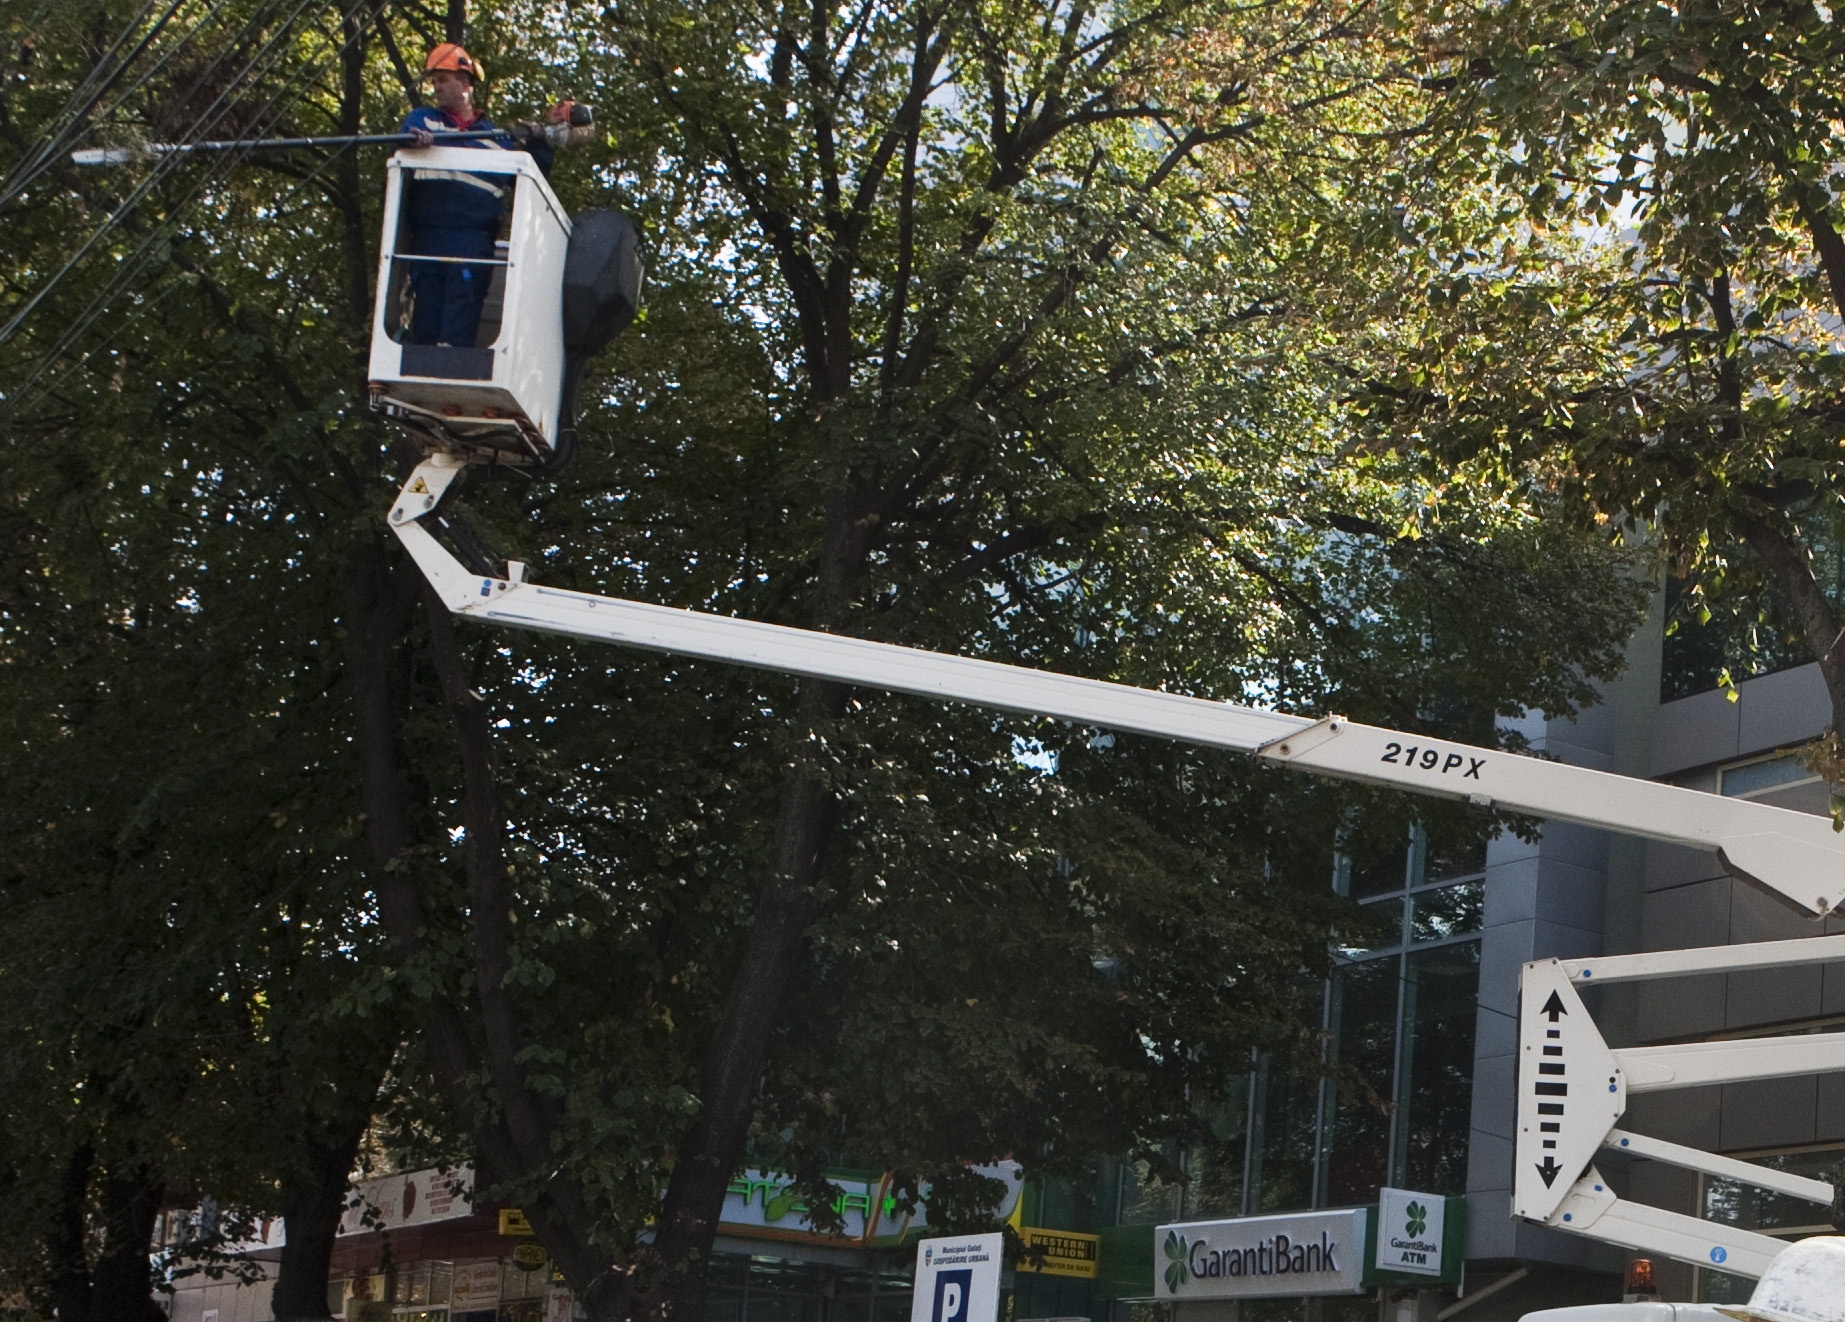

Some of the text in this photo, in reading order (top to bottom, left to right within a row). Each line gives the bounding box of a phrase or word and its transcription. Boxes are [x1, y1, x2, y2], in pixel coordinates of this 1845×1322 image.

[1381, 742, 1487, 780] 219PX
[1032, 1235, 1087, 1250] WESTERN
[1390, 1237, 1438, 1254] GarantiBank
[1048, 1246, 1086, 1259] UNION
[1189, 1231, 1339, 1280] GarantiBank
[1401, 1251, 1427, 1265] ATM
